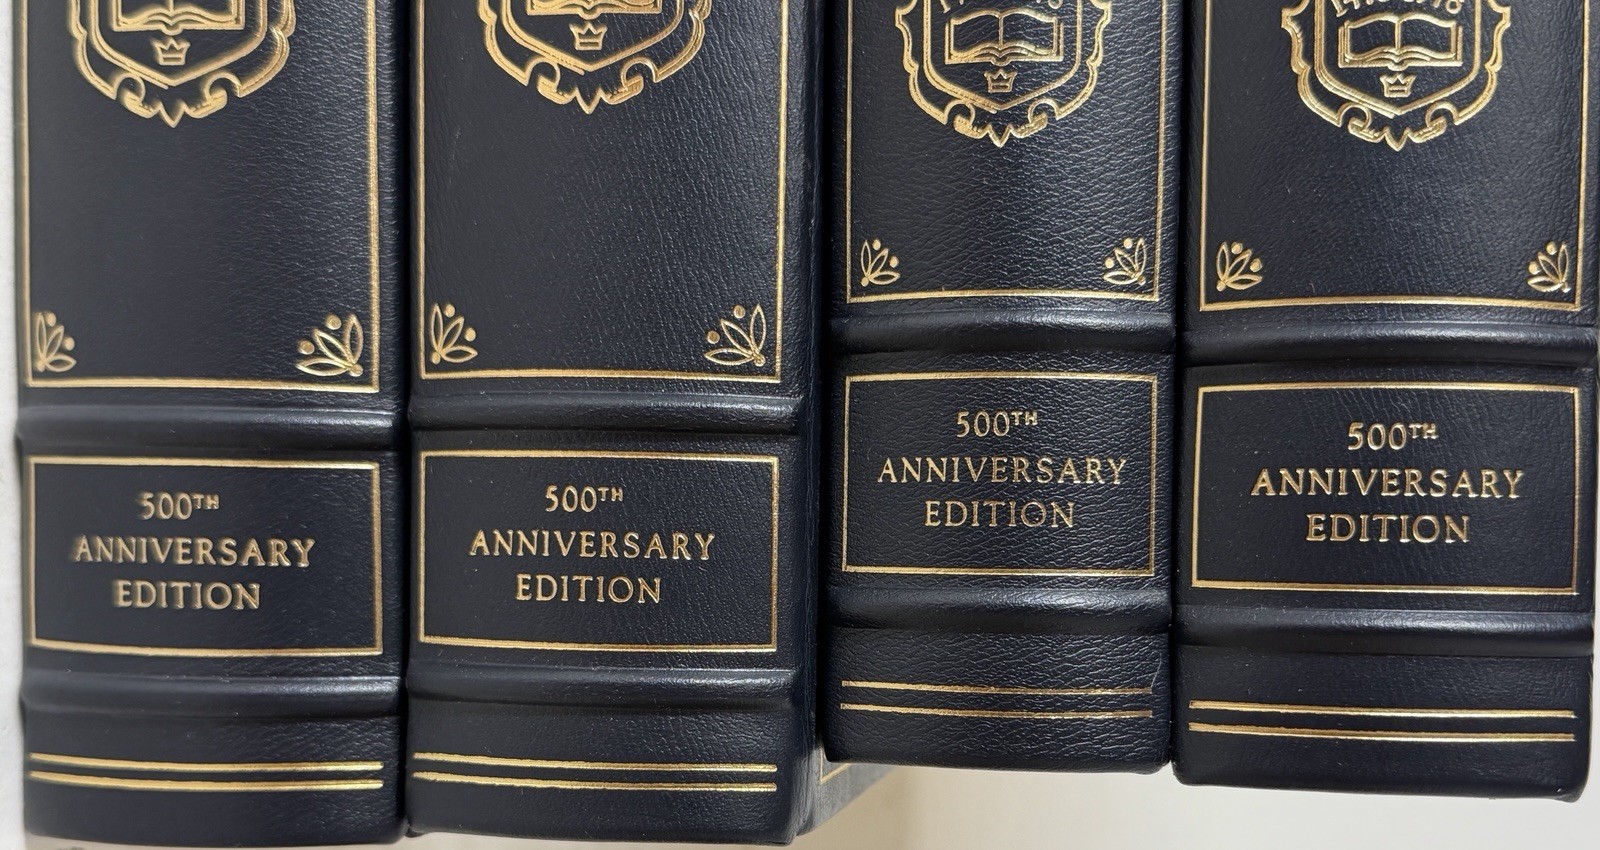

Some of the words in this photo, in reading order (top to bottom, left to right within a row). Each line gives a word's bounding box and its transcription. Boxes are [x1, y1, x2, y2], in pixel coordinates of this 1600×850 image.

[956, 410, 1038, 437] 500TH
[1348, 421, 1437, 449] 500TH
[879, 455, 1126, 484] ANNIVERSARY
[1251, 467, 1523, 498] ANNIVERSARY
[139, 491, 219, 520] 500TH
[545, 484, 624, 512] 500TH
[924, 499, 1074, 528] EDITION
[1306, 513, 1469, 543] EDITION
[74, 536, 314, 567] ANNIVERSARY
[469, 528, 714, 560] ANNIVERSARY
[115, 579, 260, 609] EDITION
[516, 573, 661, 604] EDITION
